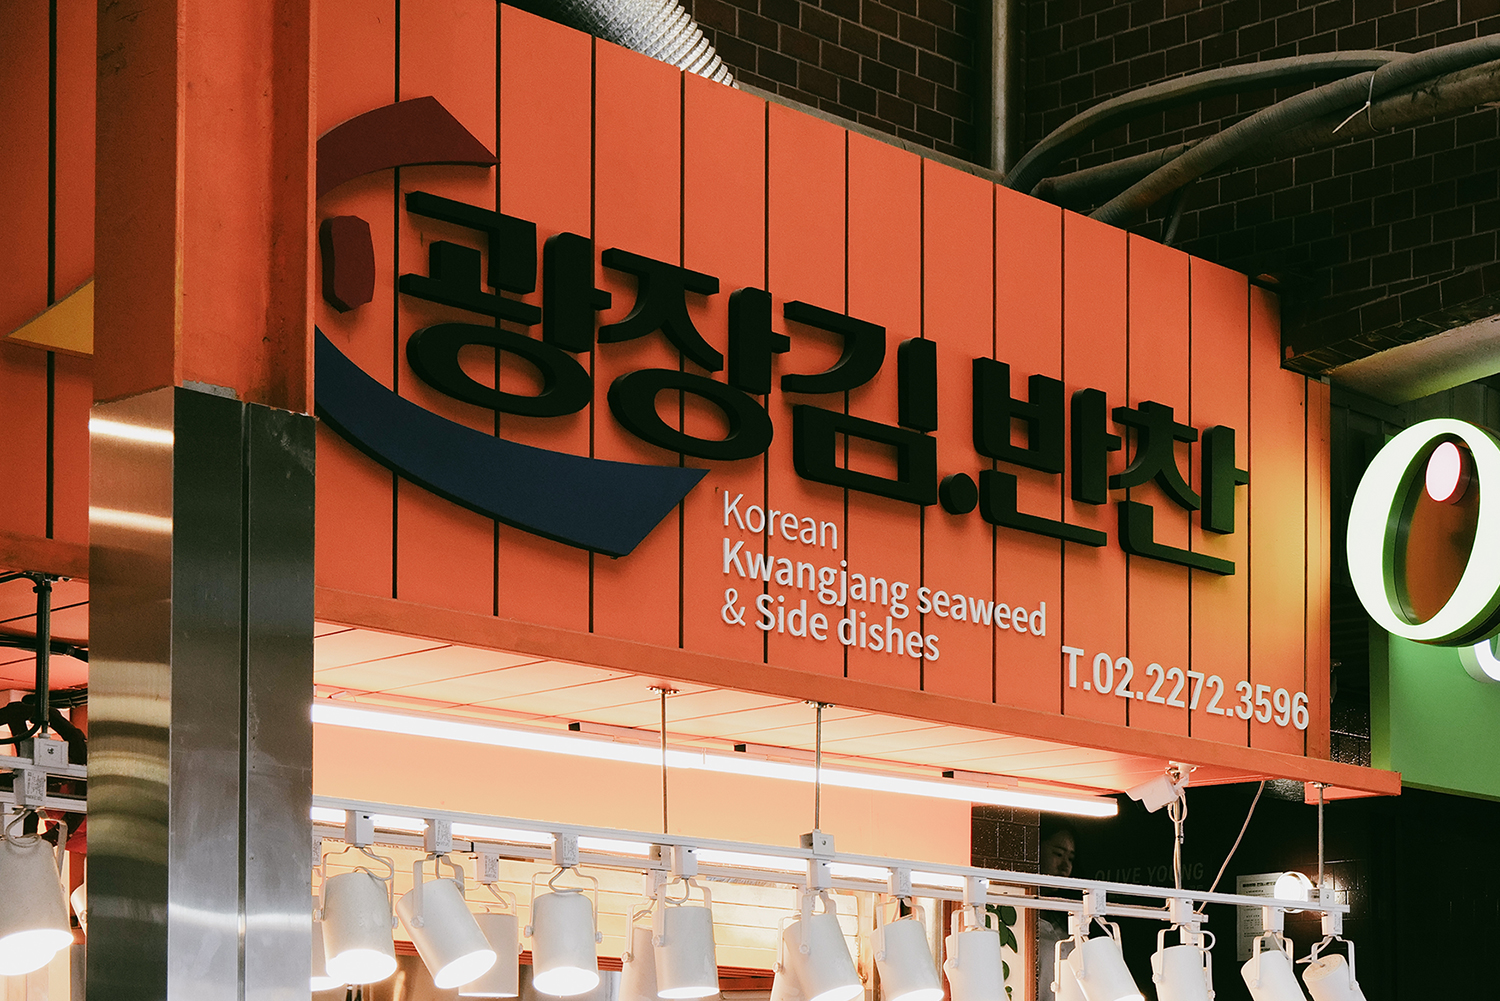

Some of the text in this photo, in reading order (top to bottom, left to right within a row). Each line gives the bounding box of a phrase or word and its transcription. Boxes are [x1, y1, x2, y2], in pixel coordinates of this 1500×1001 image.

[722, 491, 838, 551] Korean
[721, 589, 941, 663] & Side dishes
[722, 537, 1048, 638] Kwangjang seaweed
[1061, 647, 1311, 732] T.02.2272.3596
